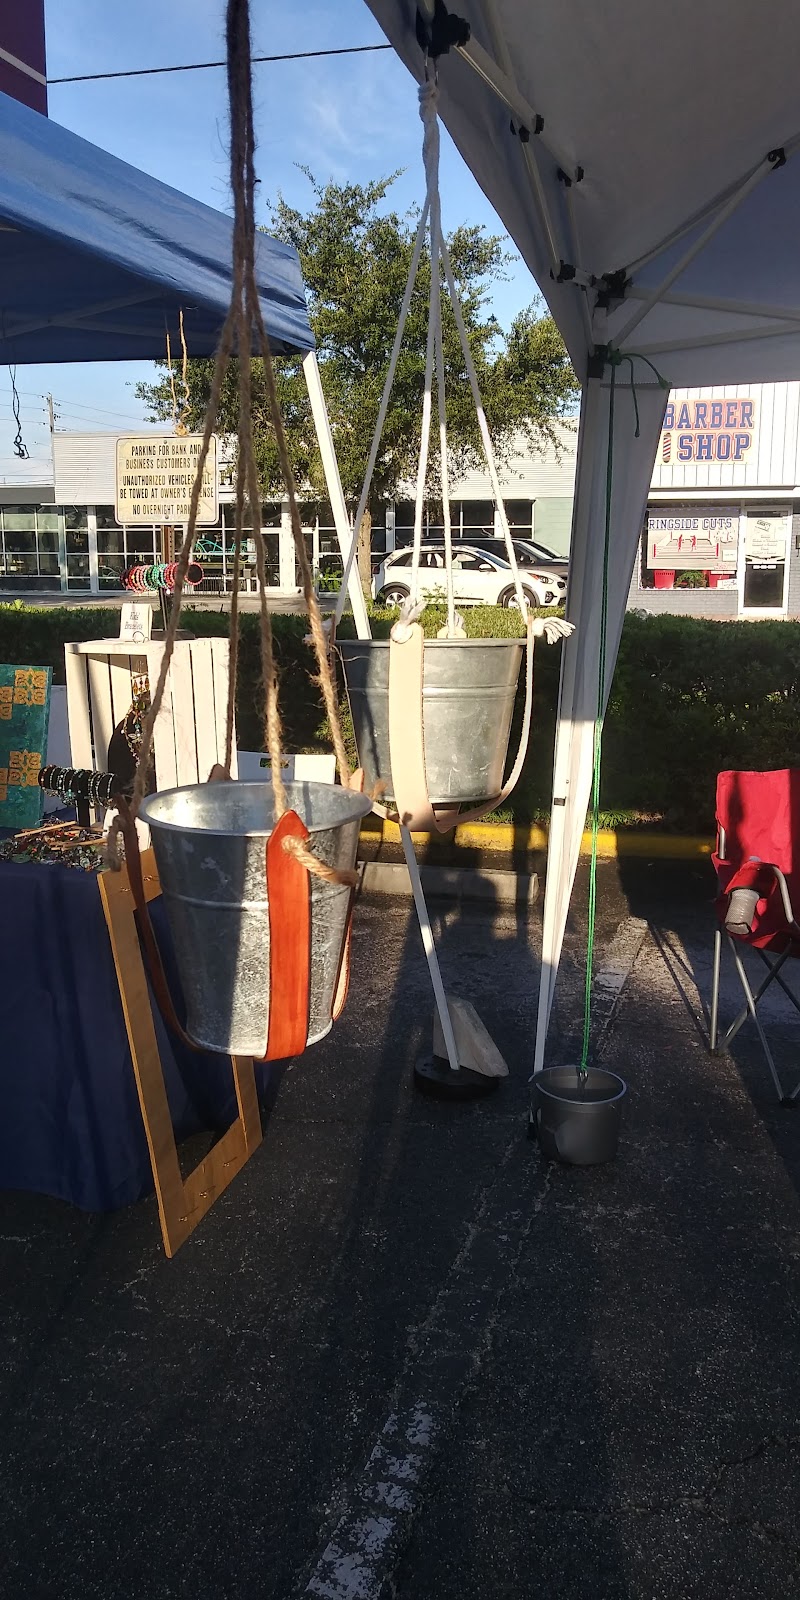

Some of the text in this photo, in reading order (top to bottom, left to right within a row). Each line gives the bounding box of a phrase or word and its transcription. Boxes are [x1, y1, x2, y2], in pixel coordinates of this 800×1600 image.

[663, 401, 754, 429] BARBER
[131, 444, 201, 456] PARKING FOR BANK AND
[678, 433, 751, 461] SHOP
[126, 459, 154, 470] BUSINESS
[156, 458, 190, 469] CUSTOMERS
[122, 475, 166, 486] UNAUTHORIZED
[168, 474, 194, 485] VEHICLES
[120, 487, 214, 498] BE TOWED AT OWNER'S EENSE
[132, 505, 140, 514] NO
[143, 504, 174, 514] OVERNIGHT
[649, 518, 732, 530] RINGSIDE CUTS
